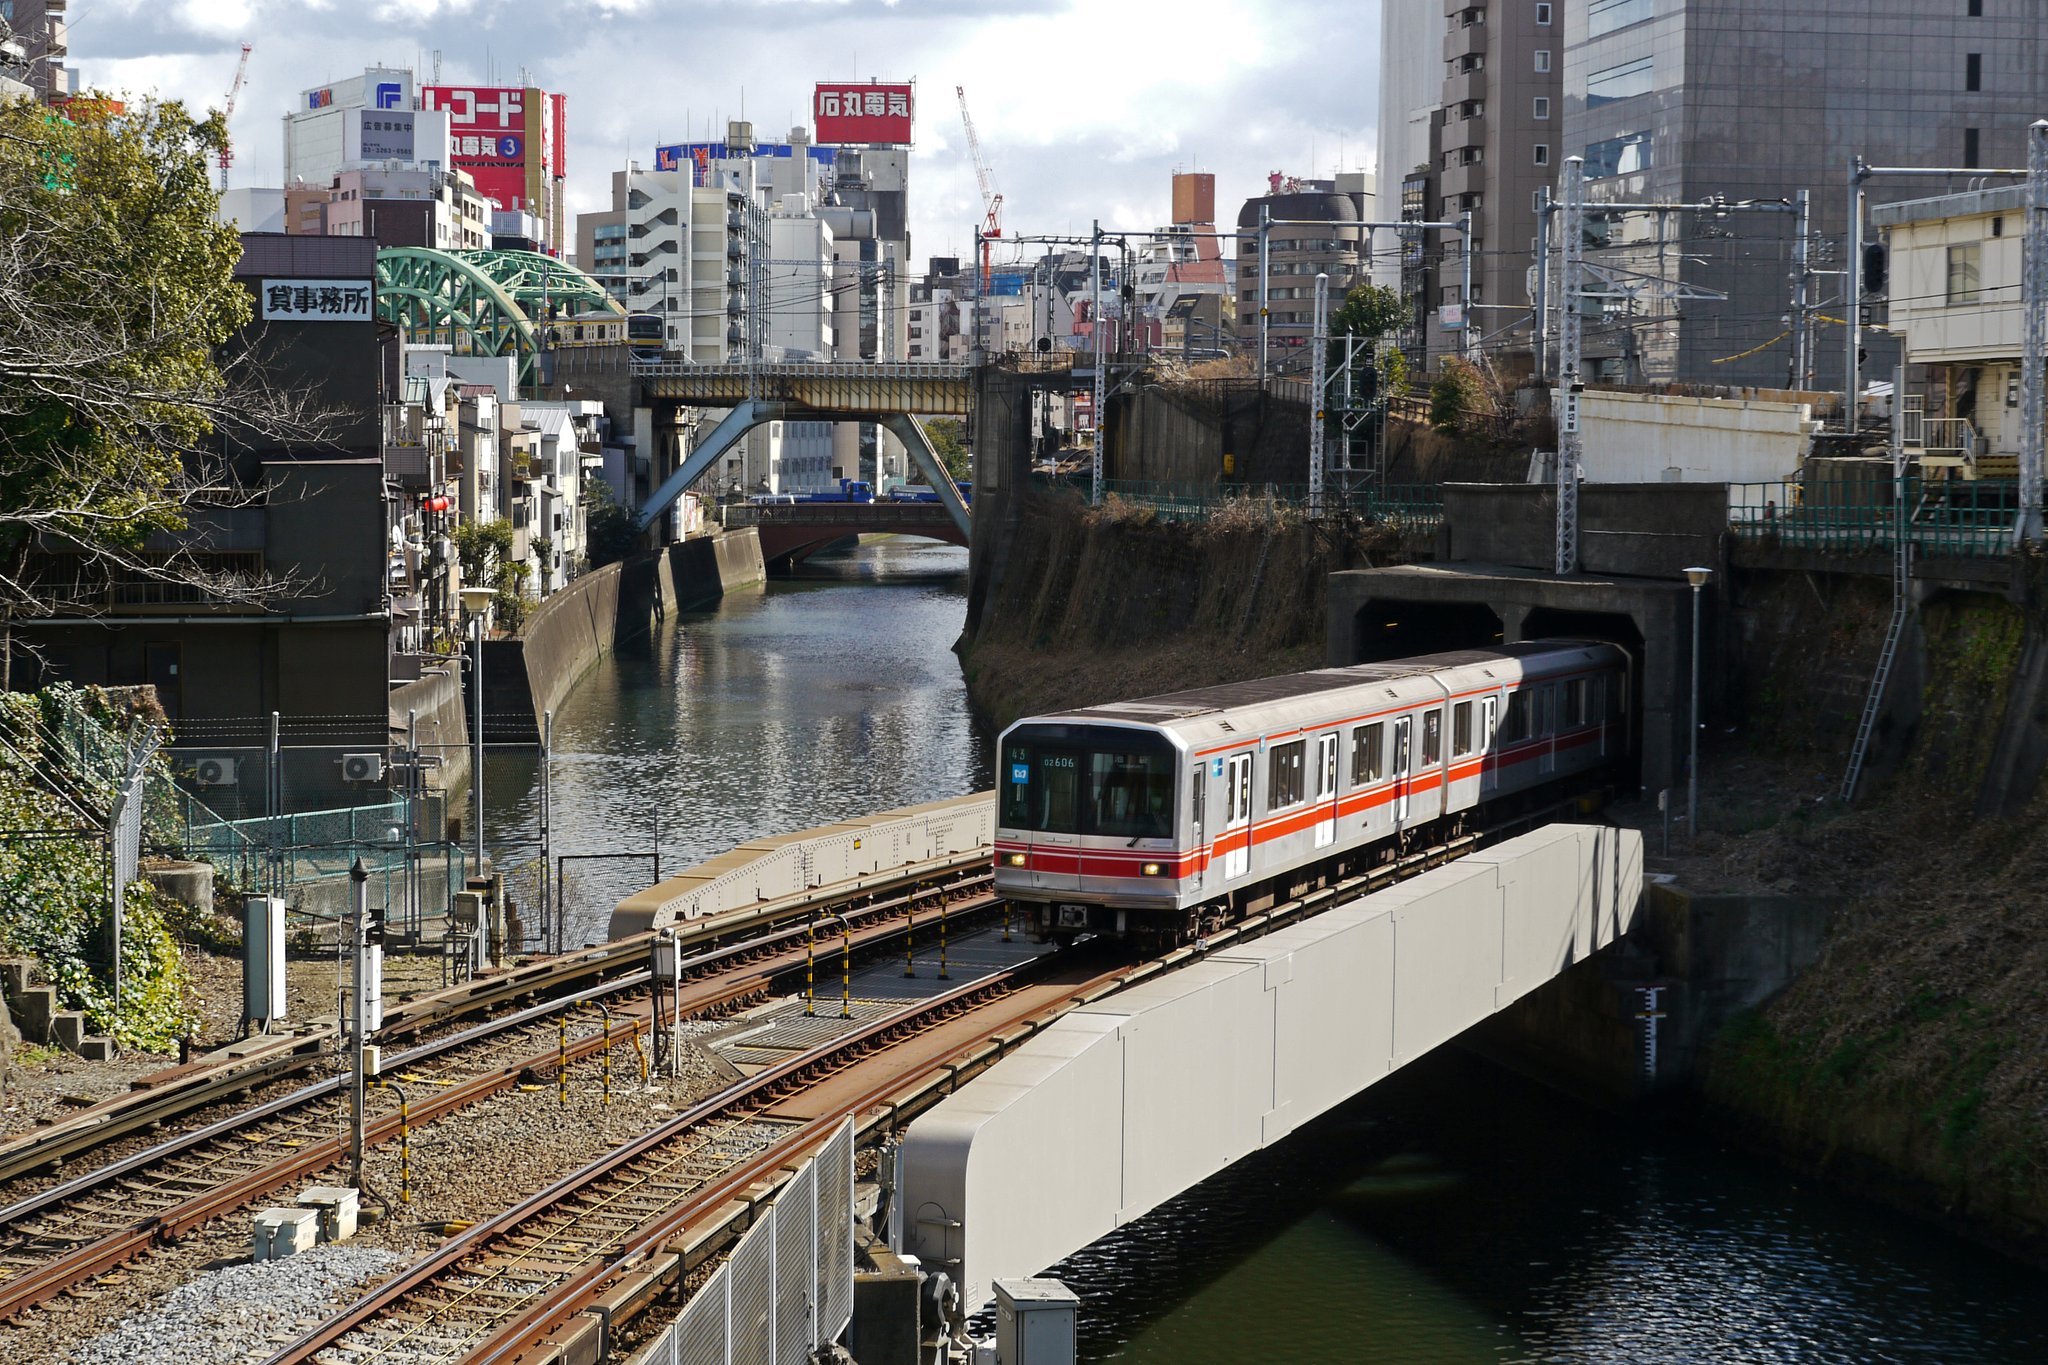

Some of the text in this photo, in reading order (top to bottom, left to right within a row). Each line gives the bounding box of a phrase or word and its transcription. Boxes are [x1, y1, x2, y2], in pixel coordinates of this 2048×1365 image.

[819, 91, 908, 117] 石丸電気
[363, 121, 412, 133] 広告募集中
[267, 285, 369, 314] 貸事務所
